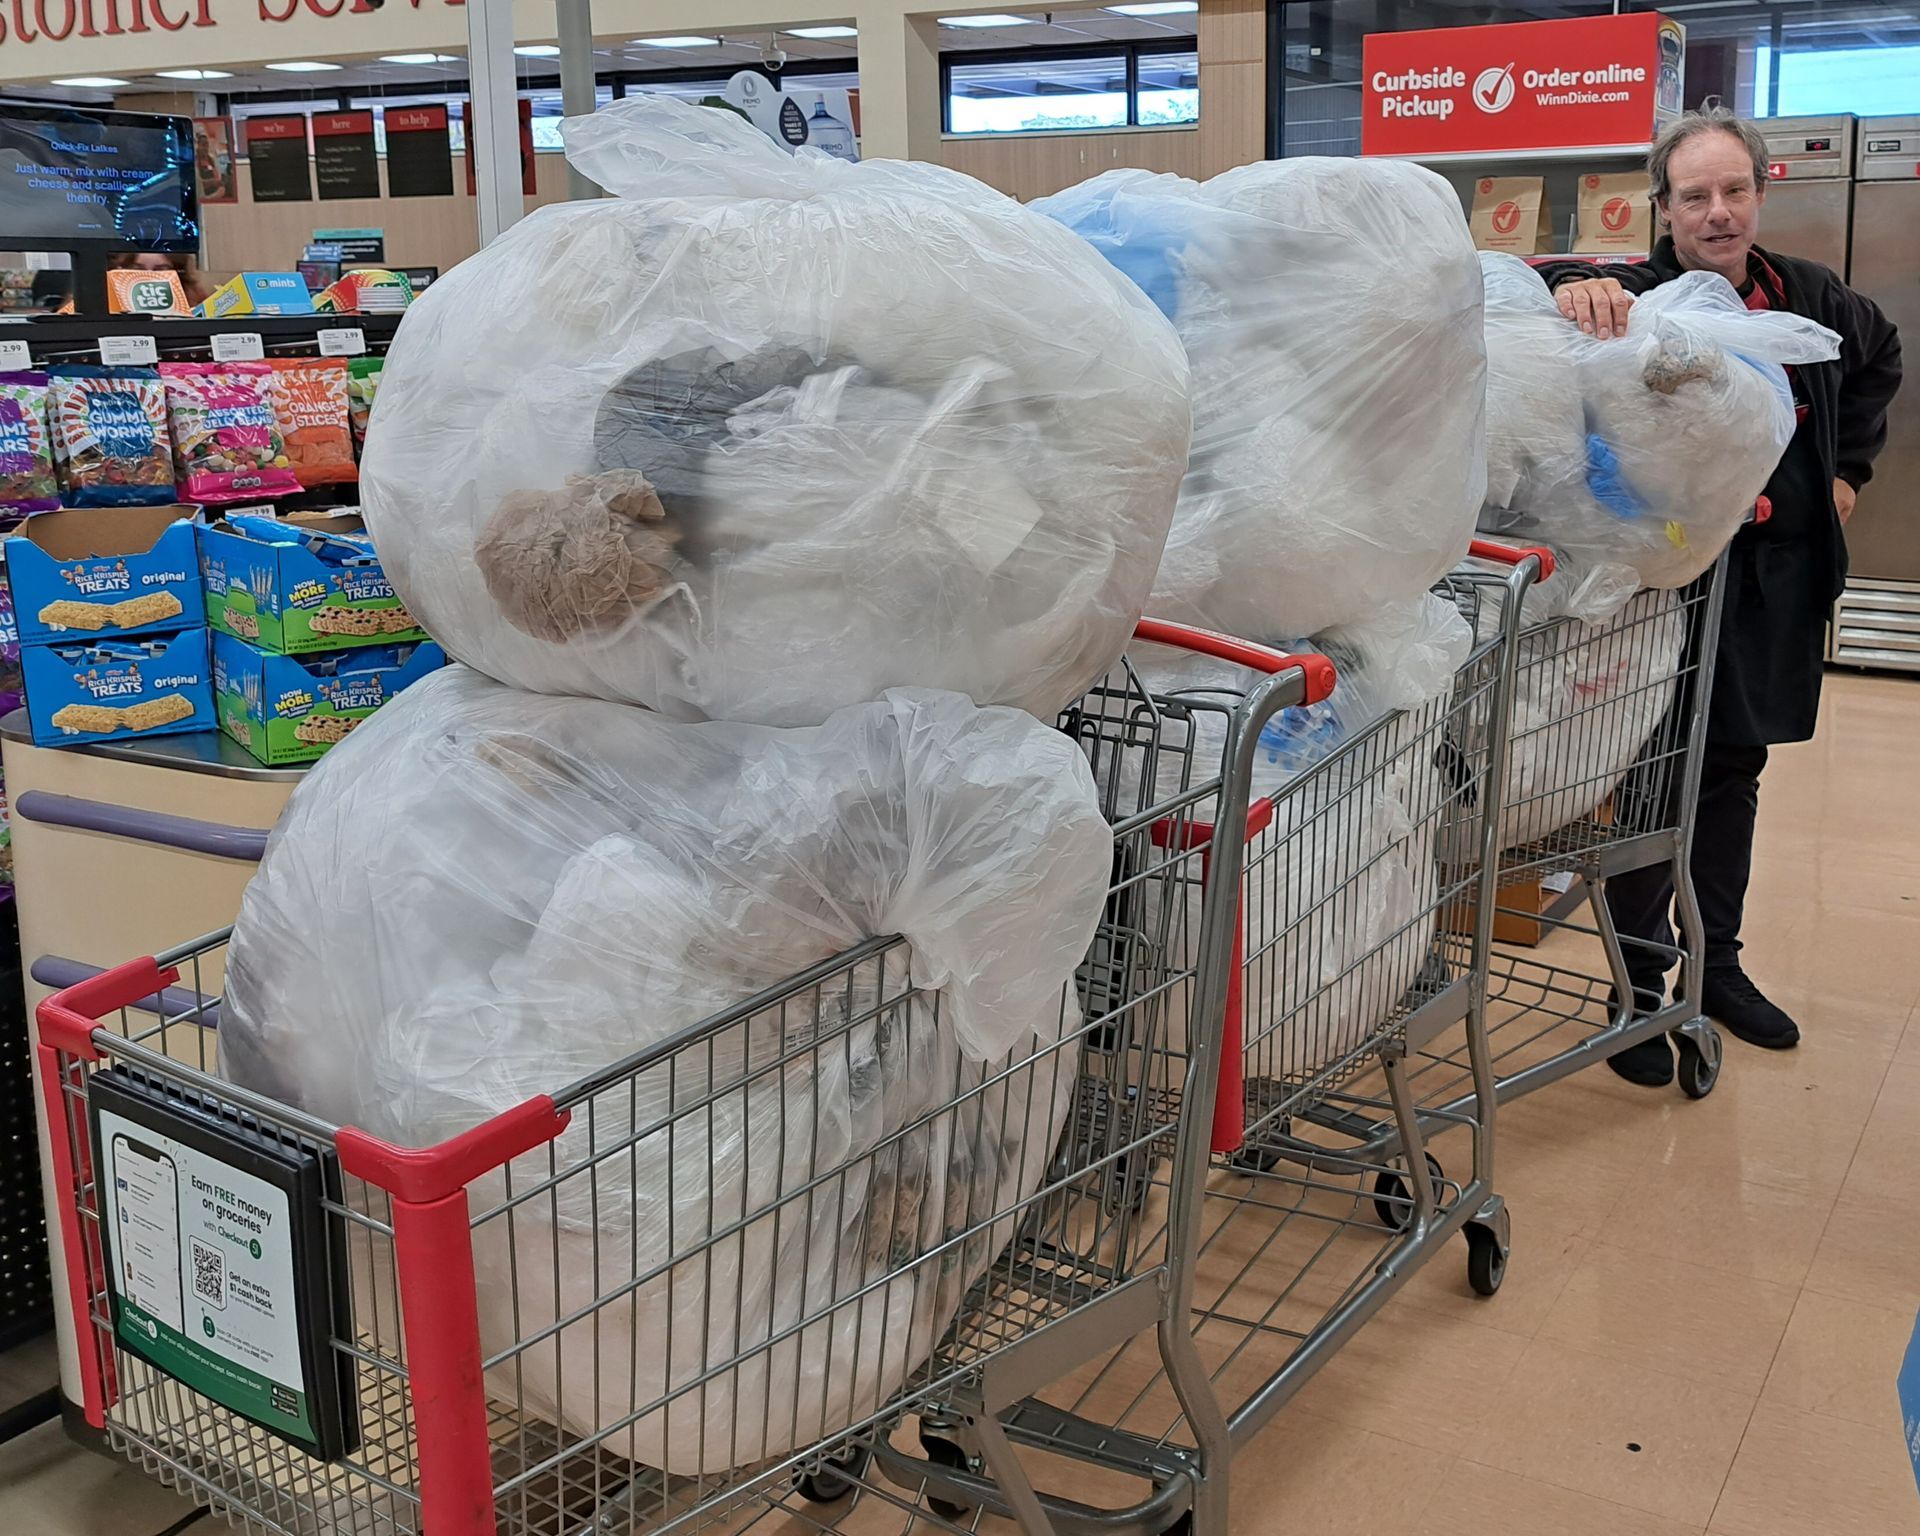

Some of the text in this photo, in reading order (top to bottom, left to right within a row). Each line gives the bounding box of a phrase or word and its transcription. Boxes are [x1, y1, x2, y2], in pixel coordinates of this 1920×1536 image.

[1372, 66, 1466, 92] Curbside
[1522, 64, 1646, 88] Order online
[1536, 91, 1630, 106] WinnDixie.com
[1382, 95, 1454, 120] Pickup
[331, 118, 351, 129] here
[400, 113, 430, 127] to help
[51, 141, 89, 152] Quick-Fix
[15, 163, 153, 179] Just warm, mix with cream
[28, 178, 69, 189] cheese
[72, 181, 92, 190] and
[66, 193, 110, 206] then fry.
[139, 283, 167, 297] tic
[269, 279, 297, 288] mints
[137, 295, 169, 308] tac
[208, 406, 265, 418] ASSORTED
[289, 402, 338, 413] ORANGE
[89, 410, 147, 424] GUMMI
[297, 415, 339, 427] SLICES
[90, 425, 153, 439] WORMS
[75, 574, 93, 584] RICE
[142, 572, 185, 584] Original
[294, 579, 315, 591] NOW
[344, 580, 360, 589] RICE
[78, 579, 130, 594] TREATS
[288, 584, 326, 602] MORE
[346, 586, 393, 600] TREATS
[88, 679, 107, 688] RICE
[154, 675, 198, 688] Original
[91, 682, 142, 698] TREATS
[280, 689, 302, 700] NOW
[331, 690, 348, 700] RICE
[275, 693, 312, 711] MORE
[333, 695, 382, 710] TREATS
[192, 1175, 273, 1227] Earn FREE money
[202, 1198, 262, 1234] on groceries
[203, 1220, 217, 1232] with
[218, 1225, 249, 1249] Checkout
[229, 1271, 271, 1298] Get an extra
[229, 1282, 237, 1293] $1
[237, 1288, 255, 1301] cash
[255, 1294, 273, 1310] back
